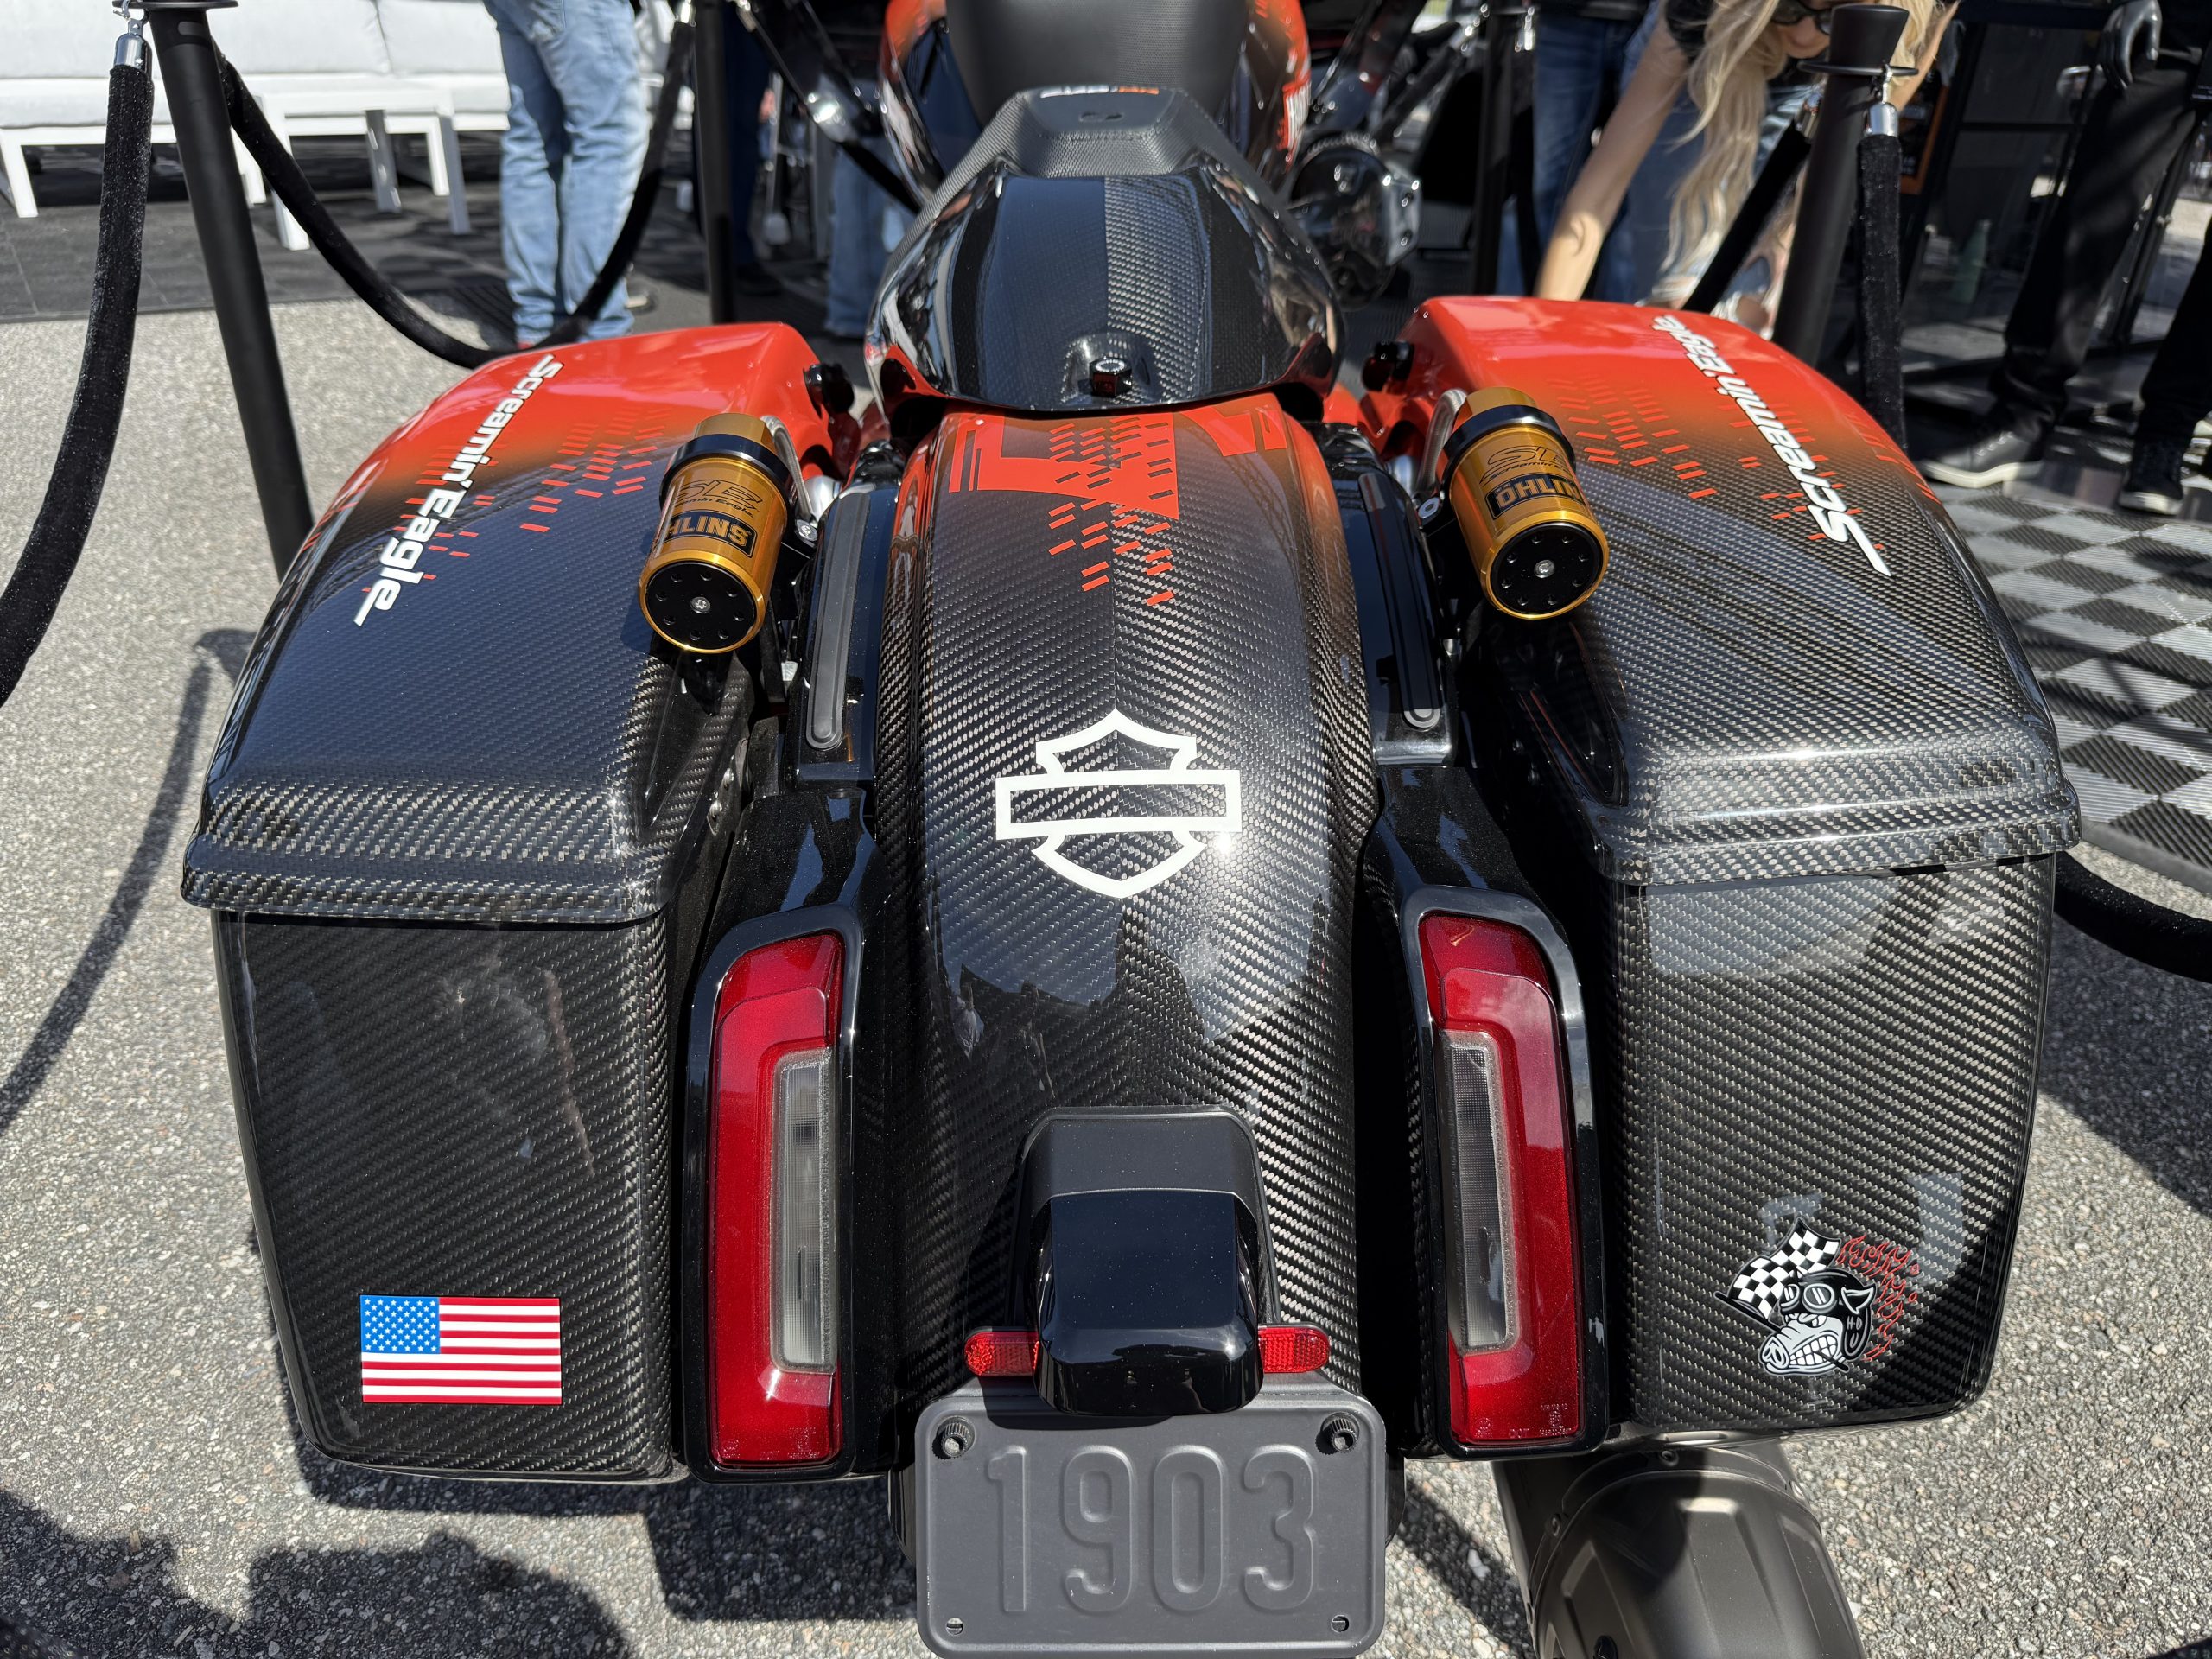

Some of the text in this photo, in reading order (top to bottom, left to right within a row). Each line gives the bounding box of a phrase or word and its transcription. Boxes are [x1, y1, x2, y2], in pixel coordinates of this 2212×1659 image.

[352, 353, 564, 627] Screamin' Eagle
[1494, 477, 1584, 510] ÖHLIN
[1650, 315, 1892, 577] Screamin' Eagle
[988, 1444, 1317, 1613] 1903
